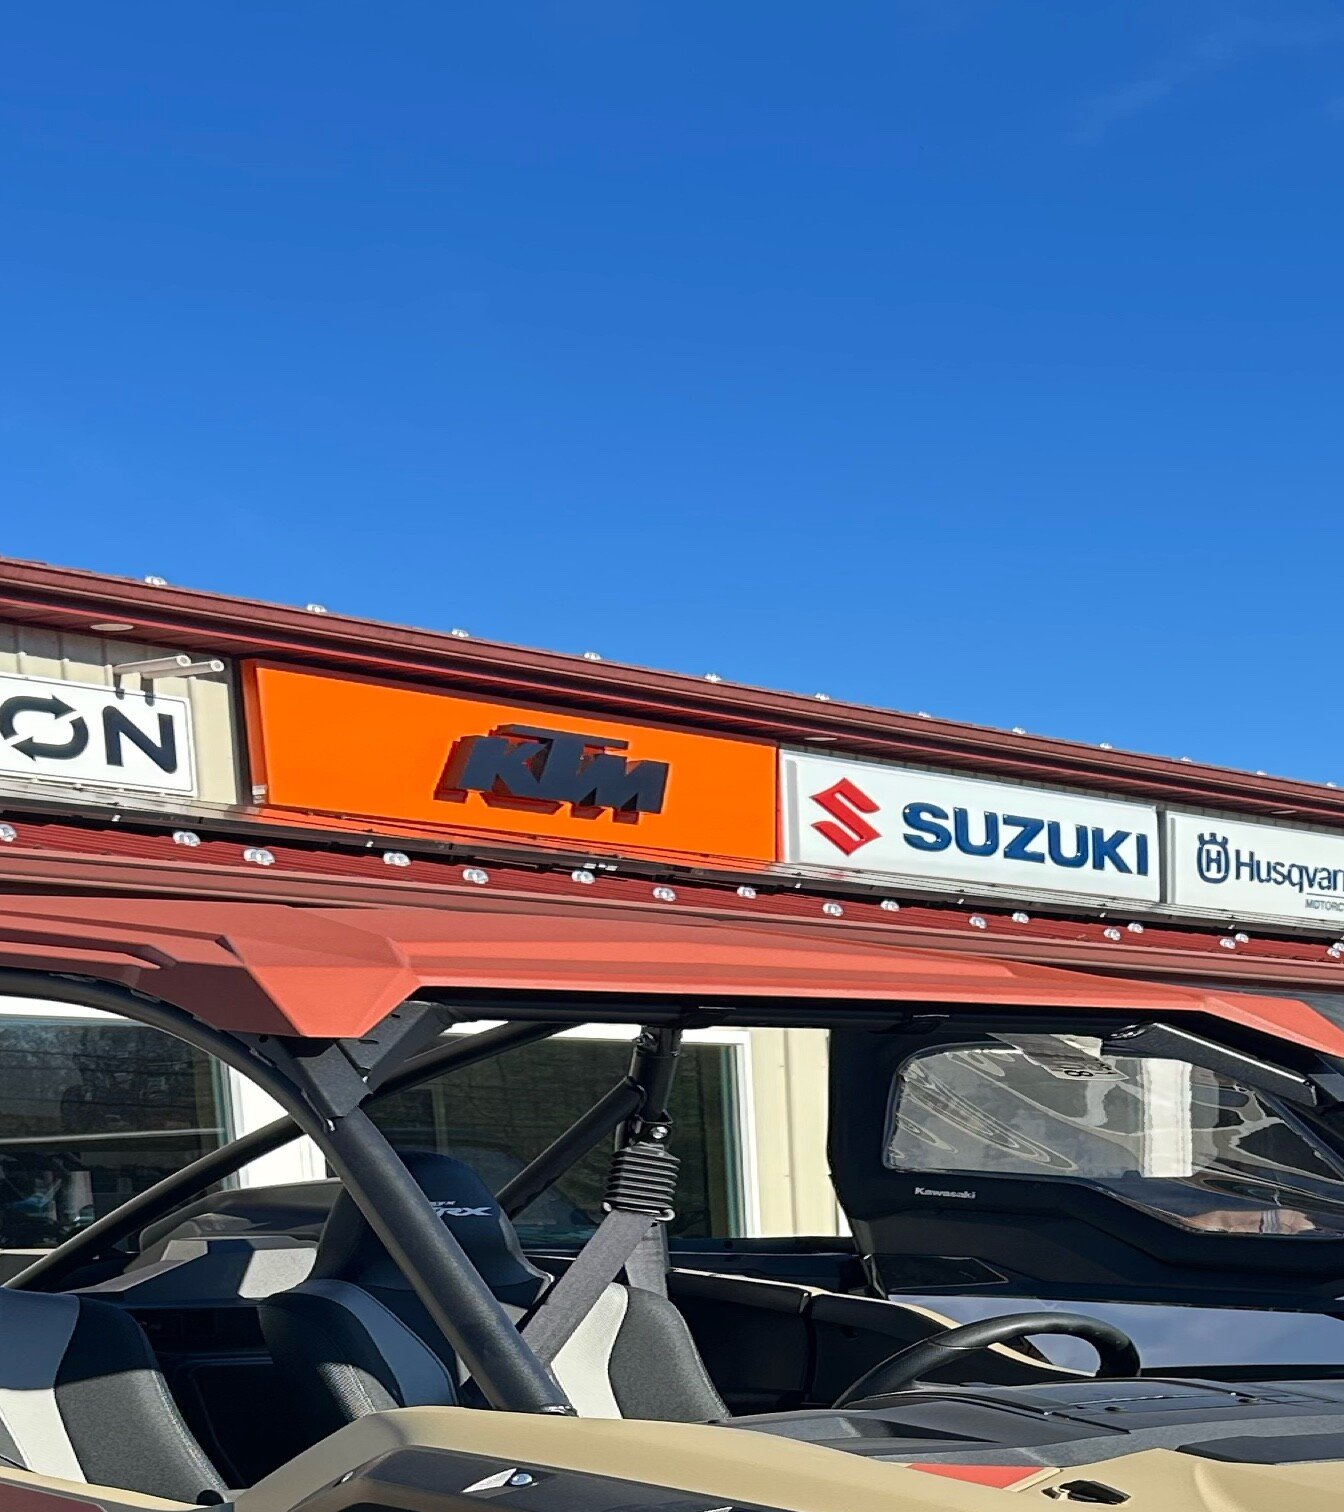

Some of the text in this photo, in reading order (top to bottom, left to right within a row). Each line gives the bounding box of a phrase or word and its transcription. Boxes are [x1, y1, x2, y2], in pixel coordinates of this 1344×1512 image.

[434, 723, 670, 823] KTM
[902, 802, 1149, 876] SUZUKI
[915, 1187, 976, 1199] Kawasaki
